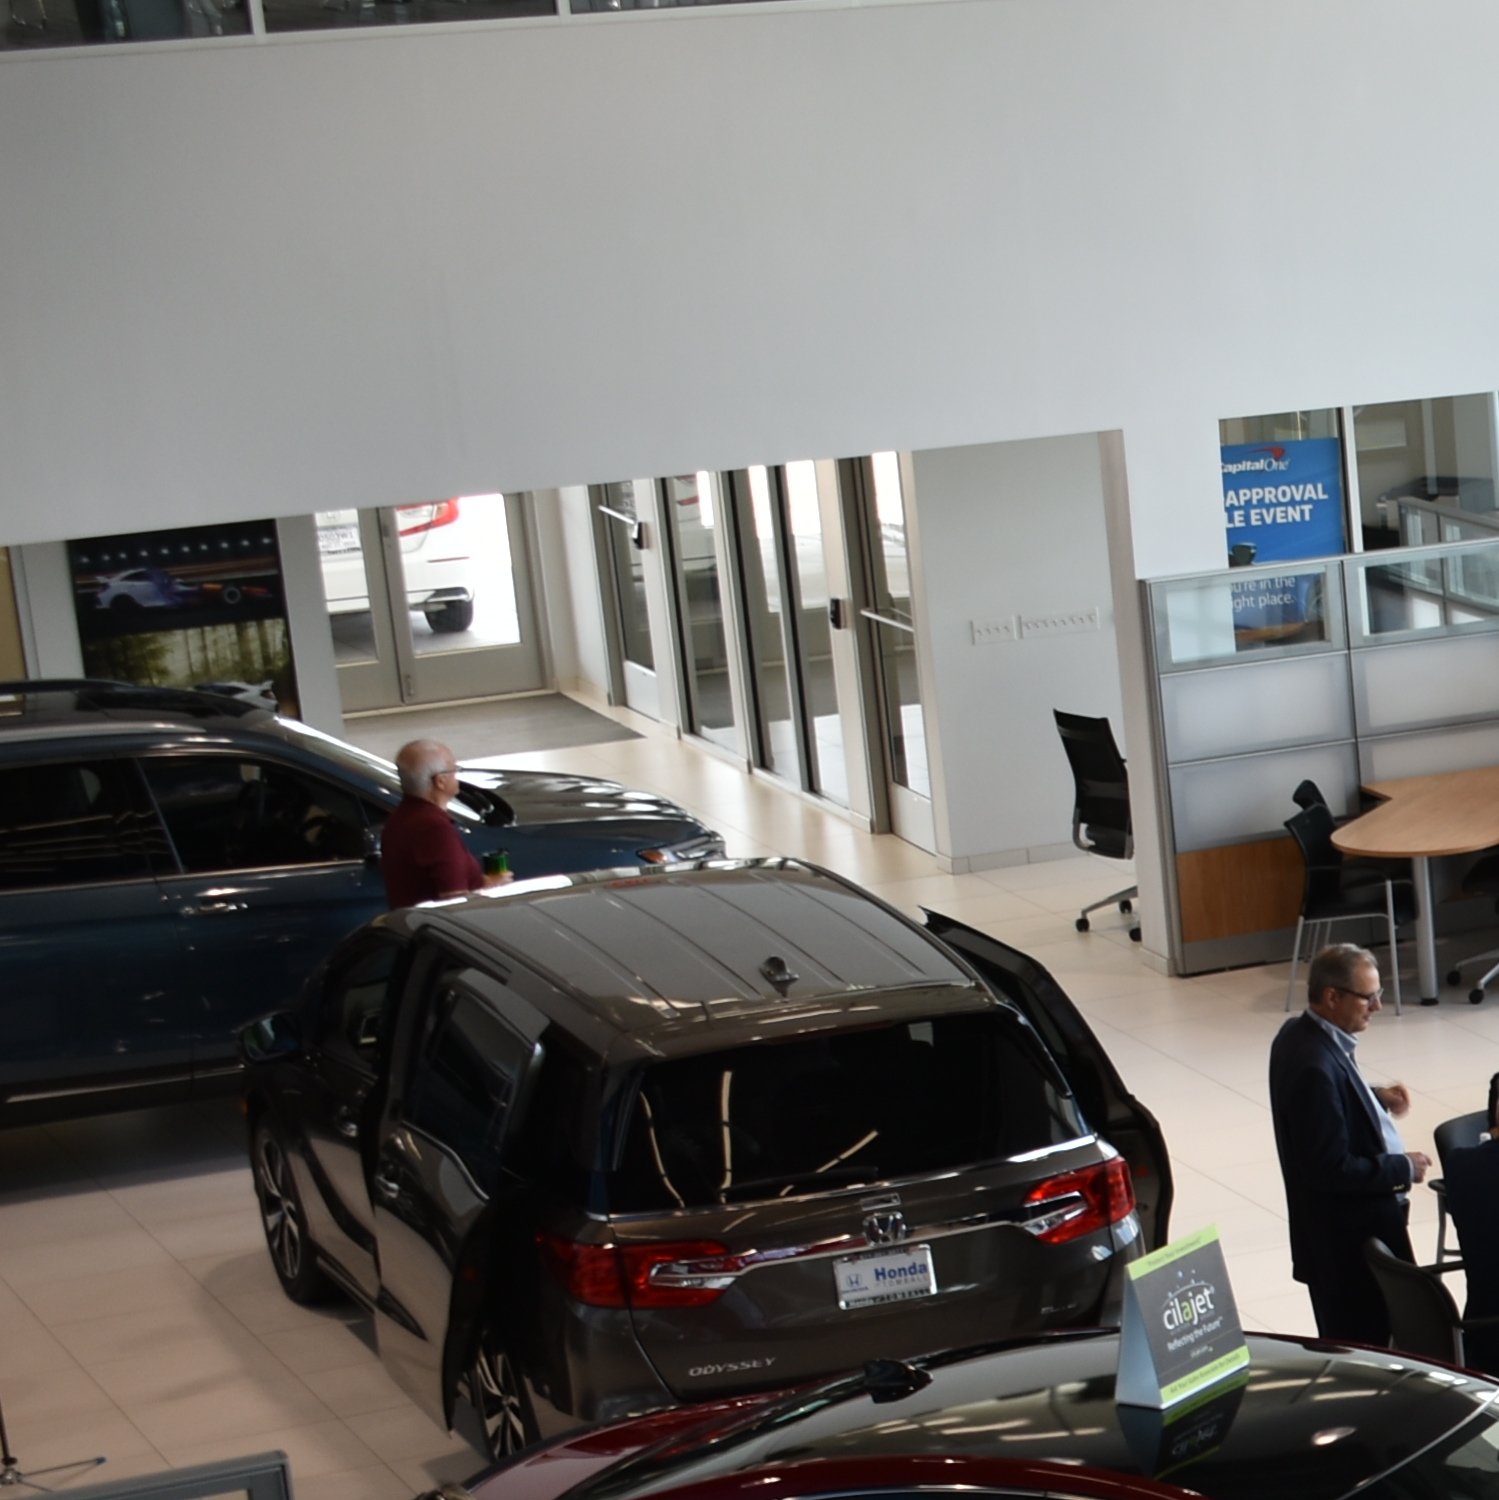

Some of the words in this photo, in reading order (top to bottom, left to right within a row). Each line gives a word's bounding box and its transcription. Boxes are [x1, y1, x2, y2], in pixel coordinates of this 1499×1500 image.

[1225, 482, 1329, 508] APPROVAL
[1250, 504, 1313, 526] EVENT
[1275, 576, 1296, 589] the
[874, 1262, 928, 1281] Honda
[1163, 1287, 1214, 1330] cilajet
[688, 1355, 777, 1377] ODYSSEY
